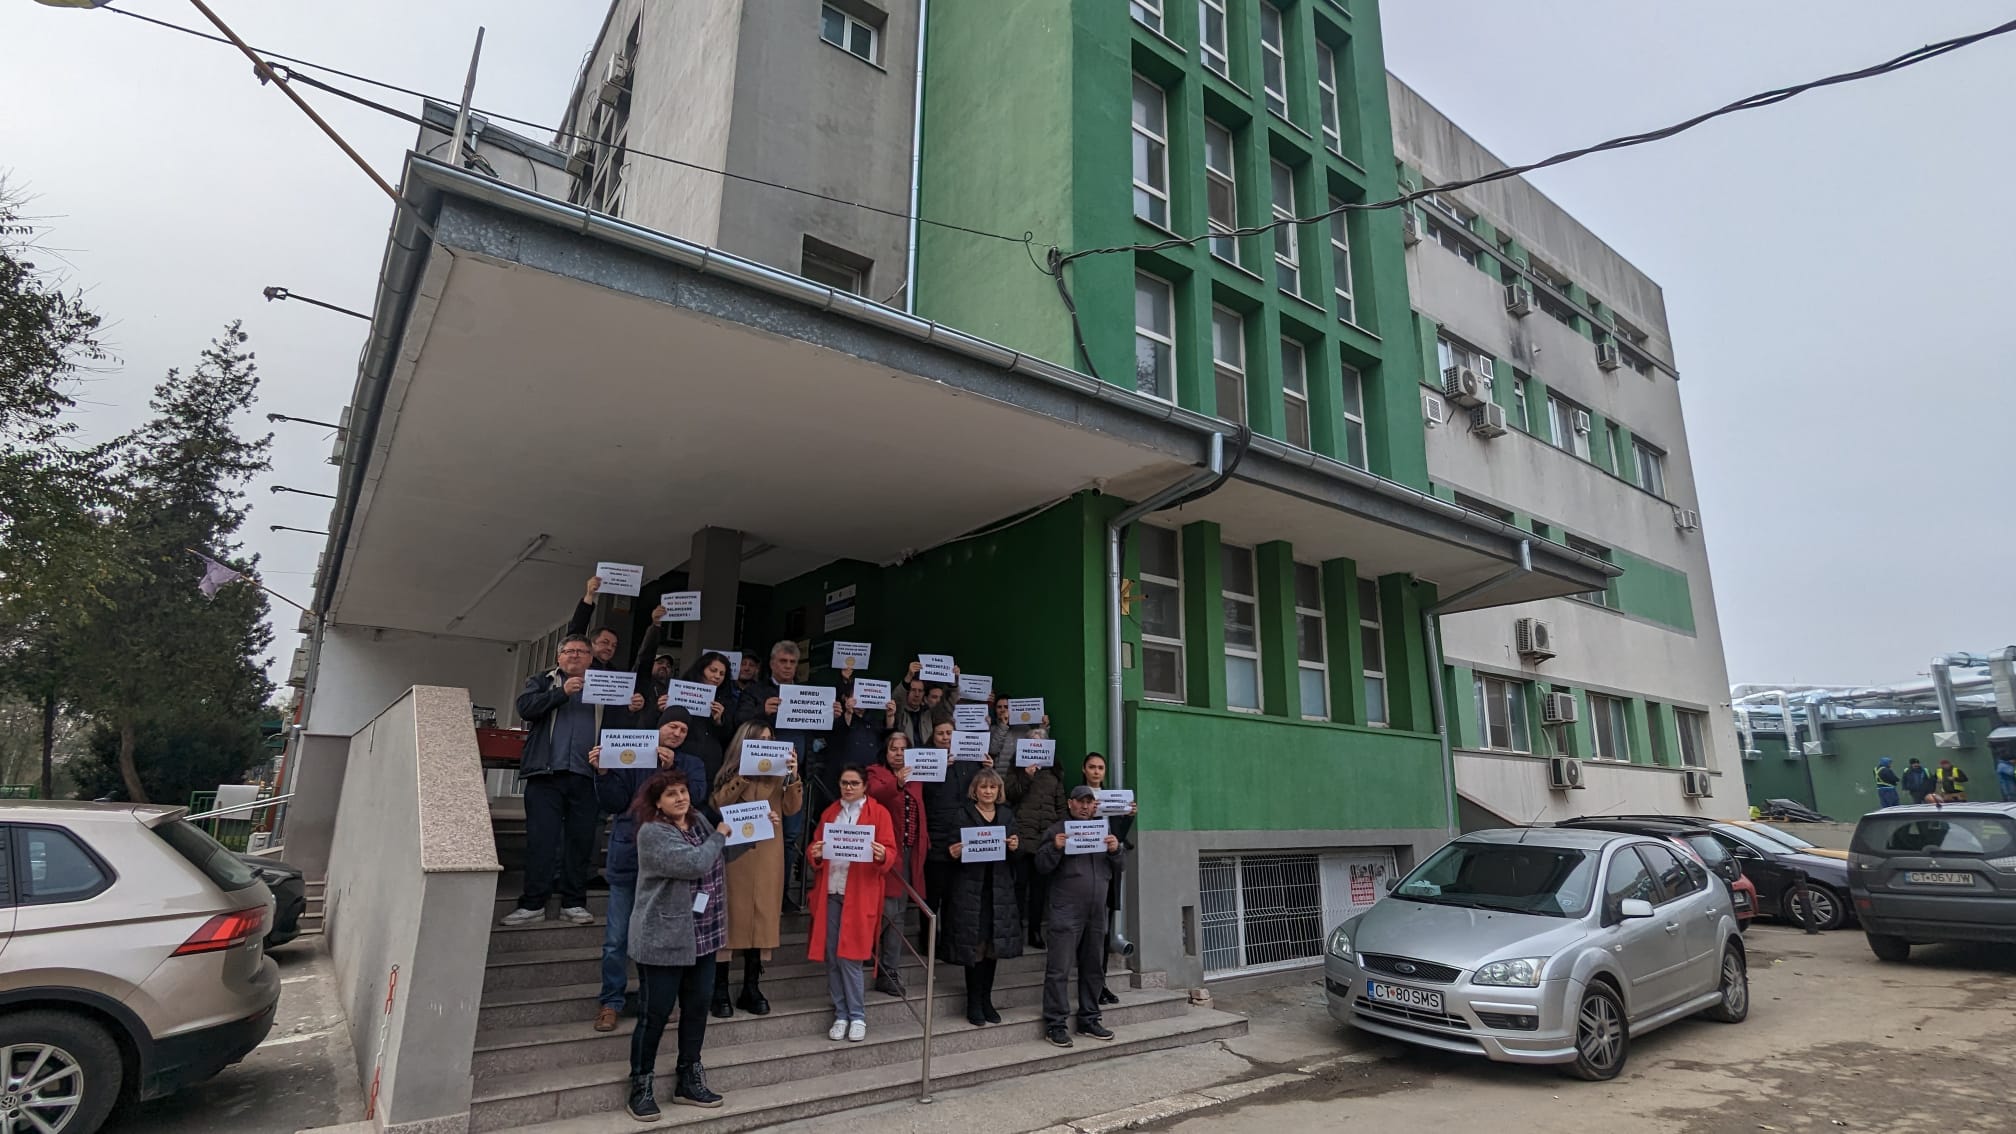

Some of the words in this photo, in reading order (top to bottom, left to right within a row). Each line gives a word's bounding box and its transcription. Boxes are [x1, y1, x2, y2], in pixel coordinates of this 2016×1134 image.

[1376, 984, 1391, 998] CT
[1396, 988, 1410, 1002] 80
[1412, 990, 1439, 1008] SMS
